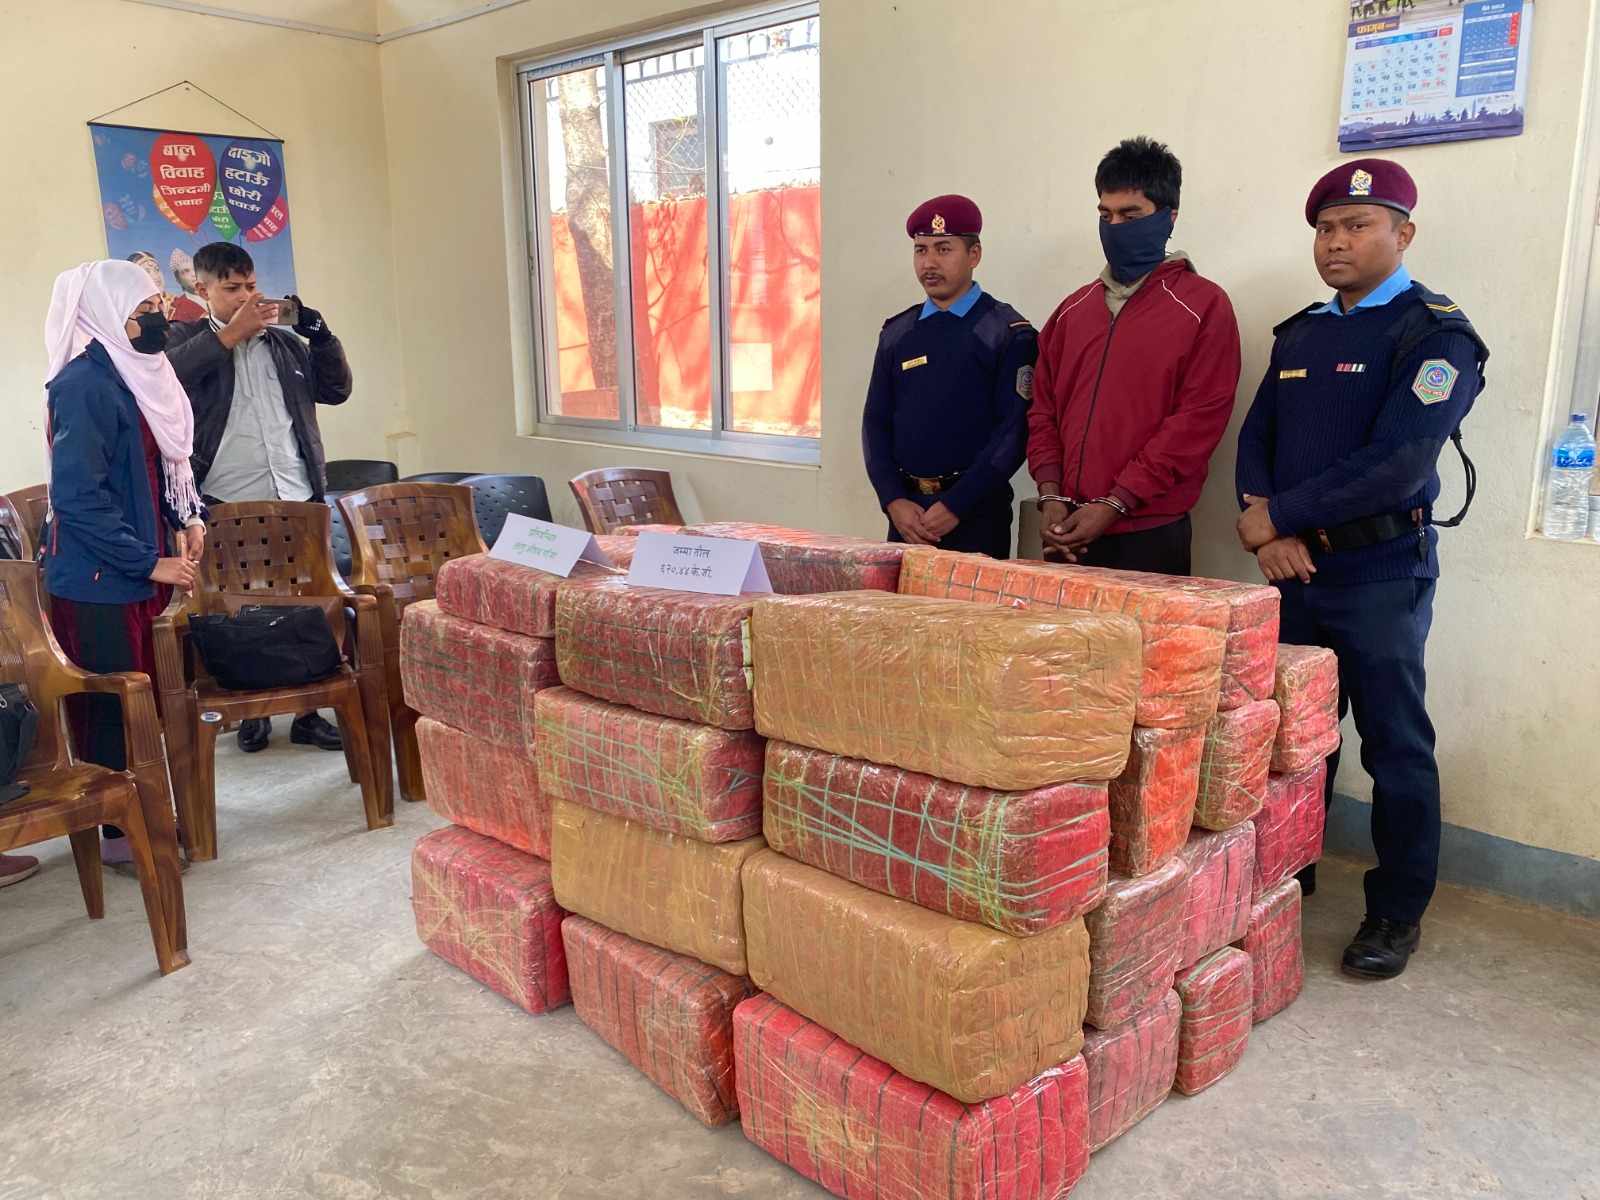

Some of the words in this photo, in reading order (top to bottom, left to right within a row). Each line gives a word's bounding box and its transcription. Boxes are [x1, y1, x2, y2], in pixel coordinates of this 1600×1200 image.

[163, 144, 196, 157] बाल
[160, 164, 205, 179] विवाह
[228, 185, 262, 201] छोरी
